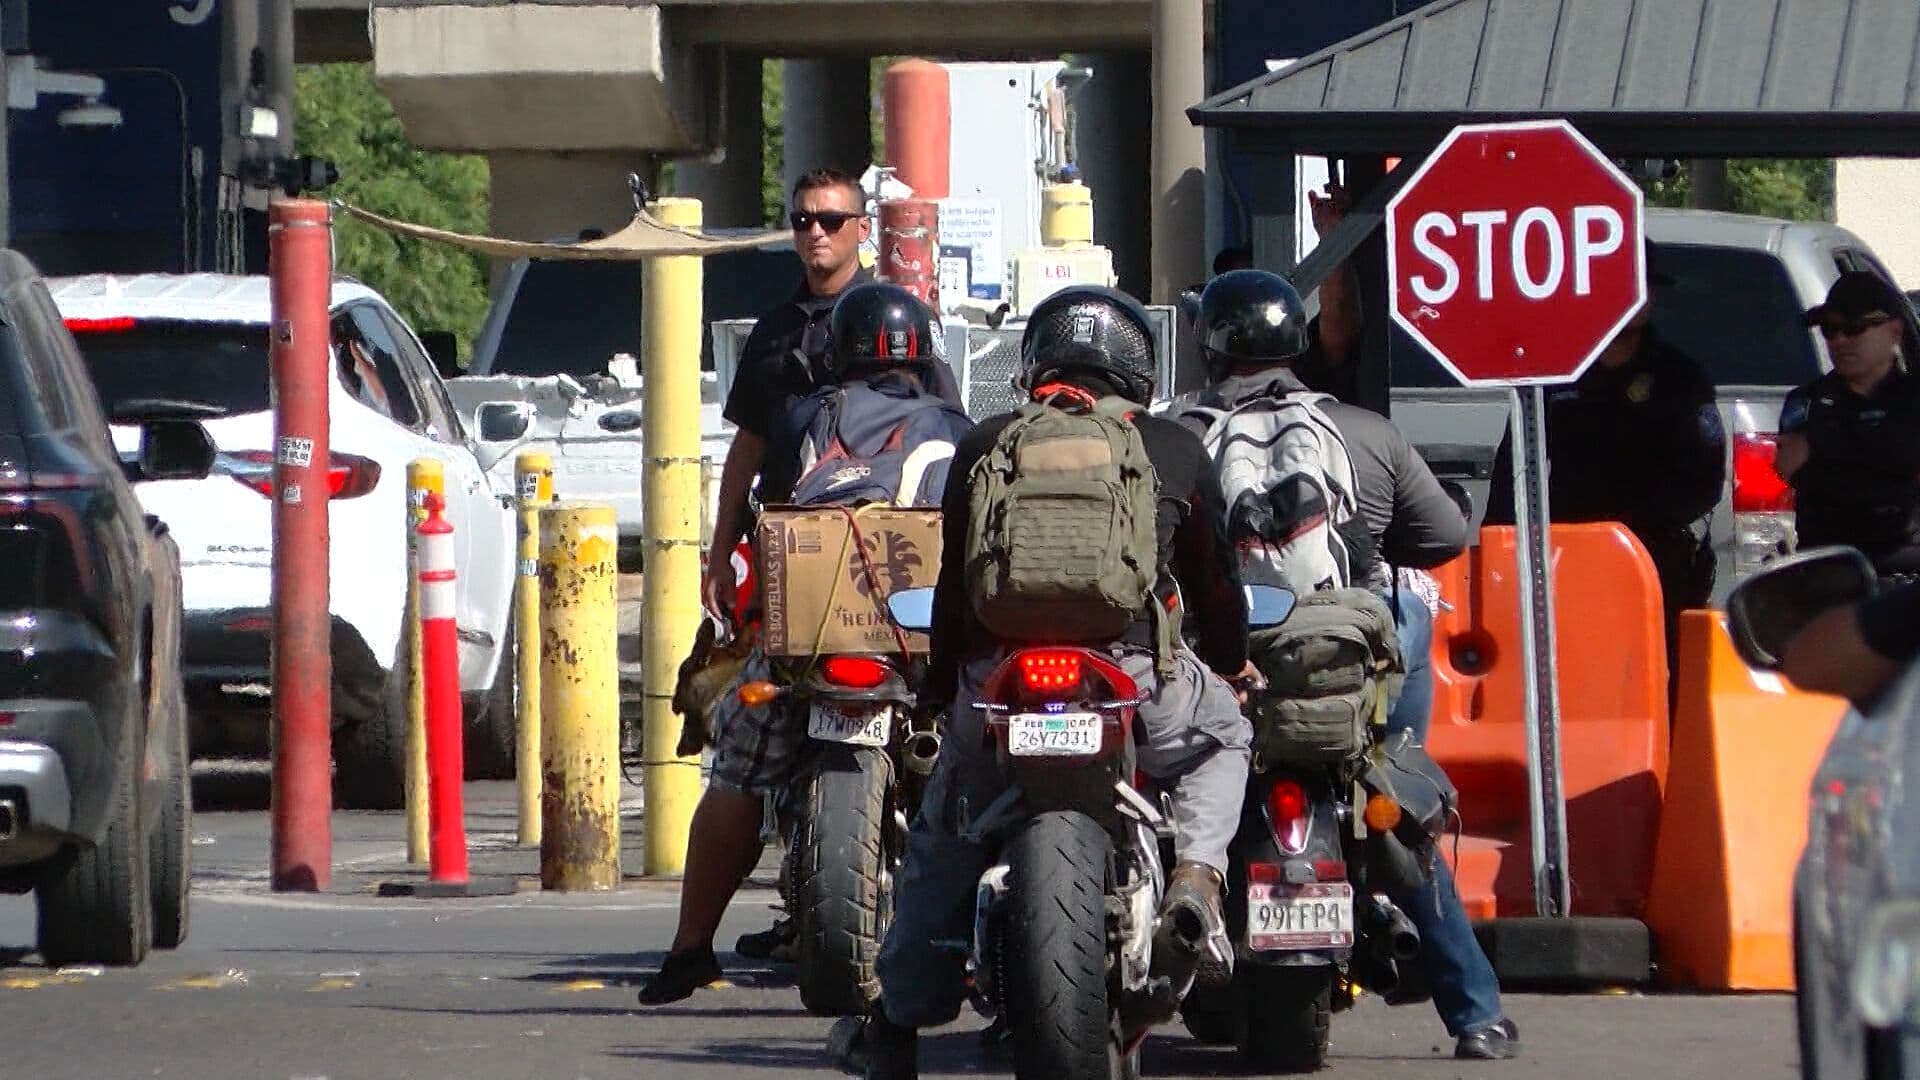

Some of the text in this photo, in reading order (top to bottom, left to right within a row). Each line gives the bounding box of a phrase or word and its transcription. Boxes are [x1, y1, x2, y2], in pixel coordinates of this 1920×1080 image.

[1409, 205, 1624, 304] STOP
[768, 561, 782, 630] BOTELLAS
[1259, 902, 1341, 931] 99FFP4
